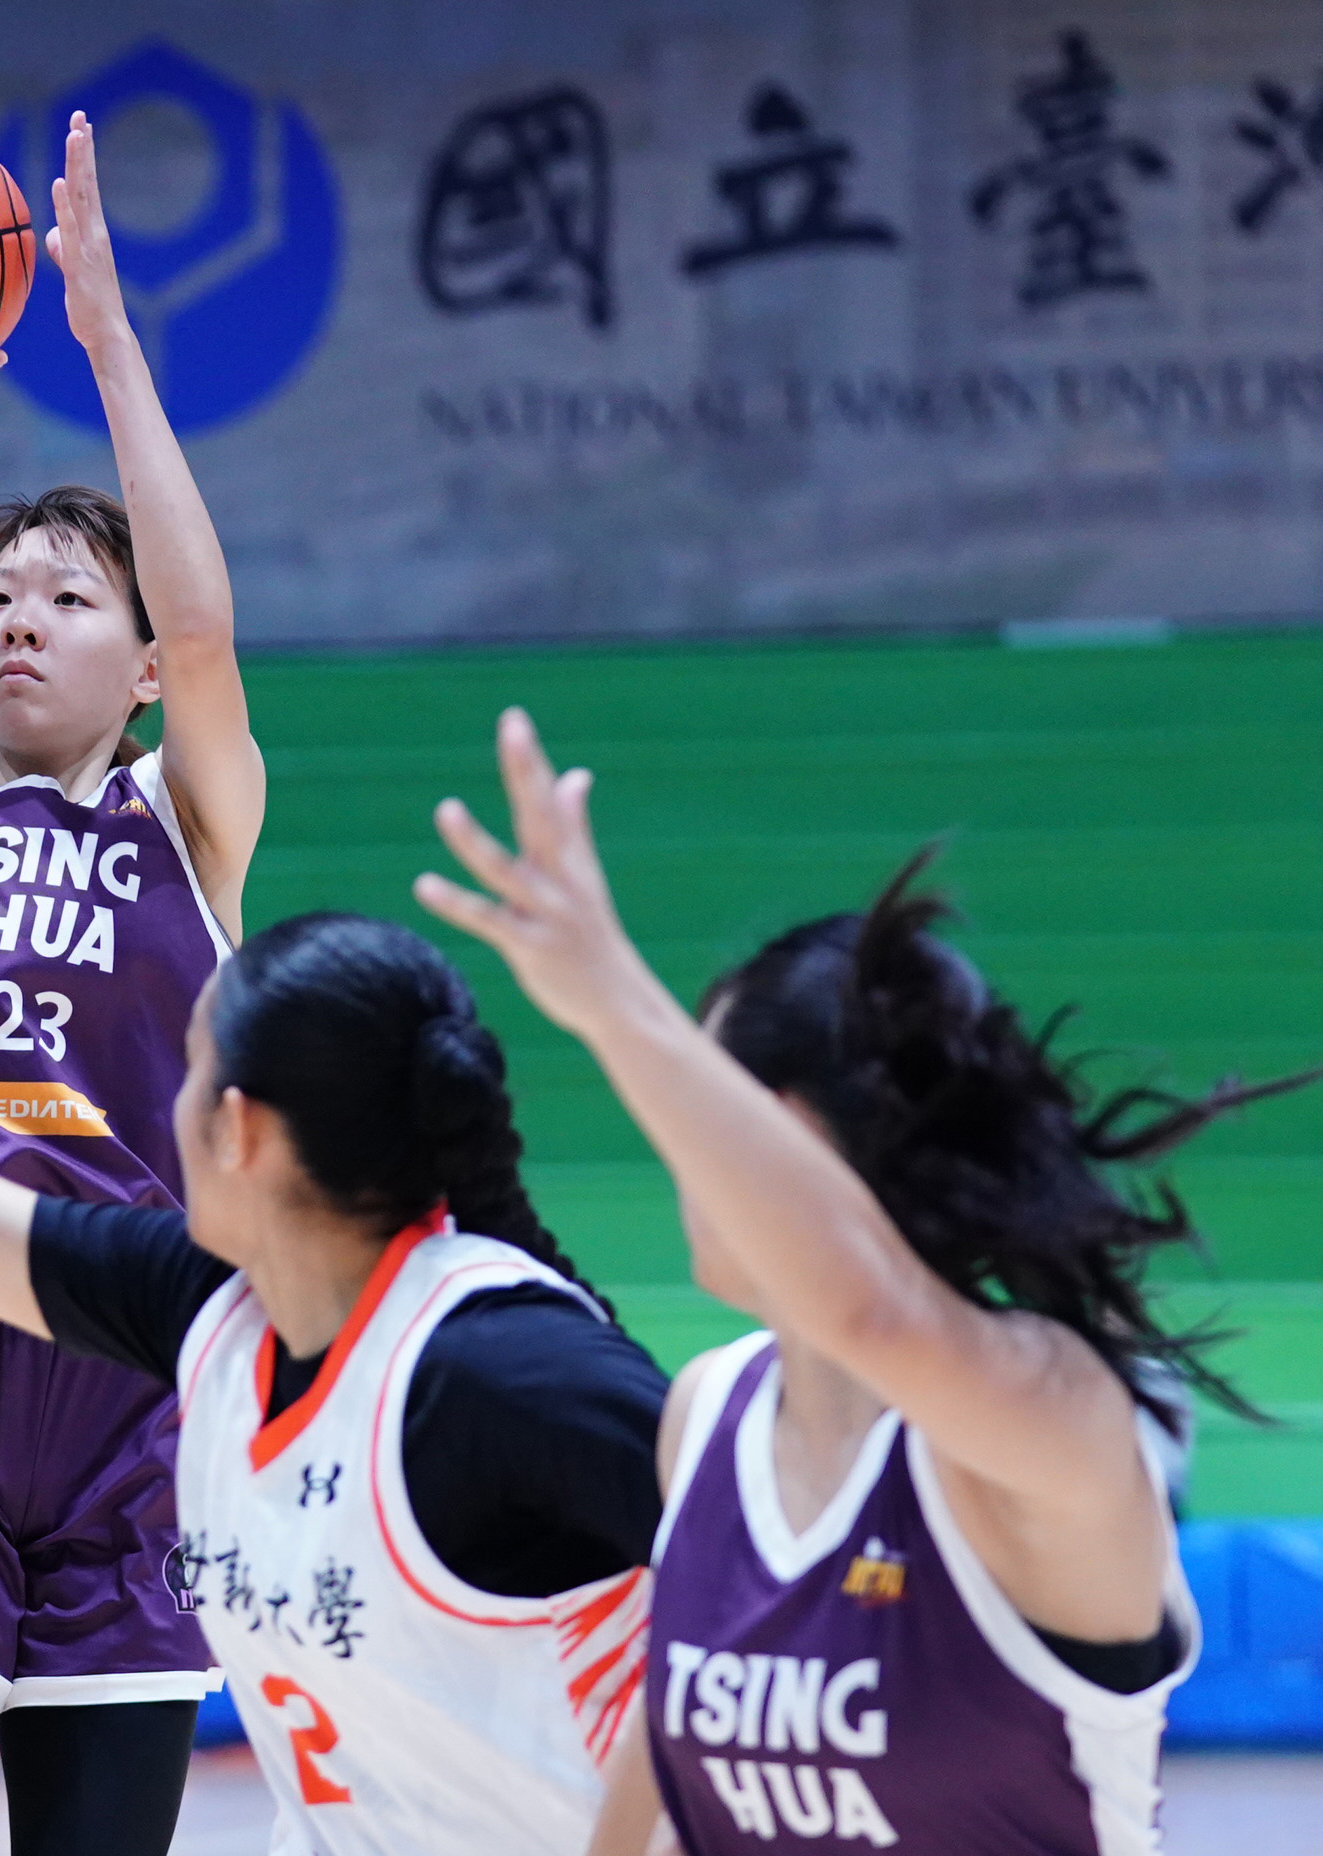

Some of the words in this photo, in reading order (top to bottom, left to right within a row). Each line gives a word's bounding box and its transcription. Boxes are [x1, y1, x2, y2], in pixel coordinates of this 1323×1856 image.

[261, 1674, 352, 1805] 2
[664, 1641, 887, 1757] TSING
[701, 1756, 899, 1847] HUA
